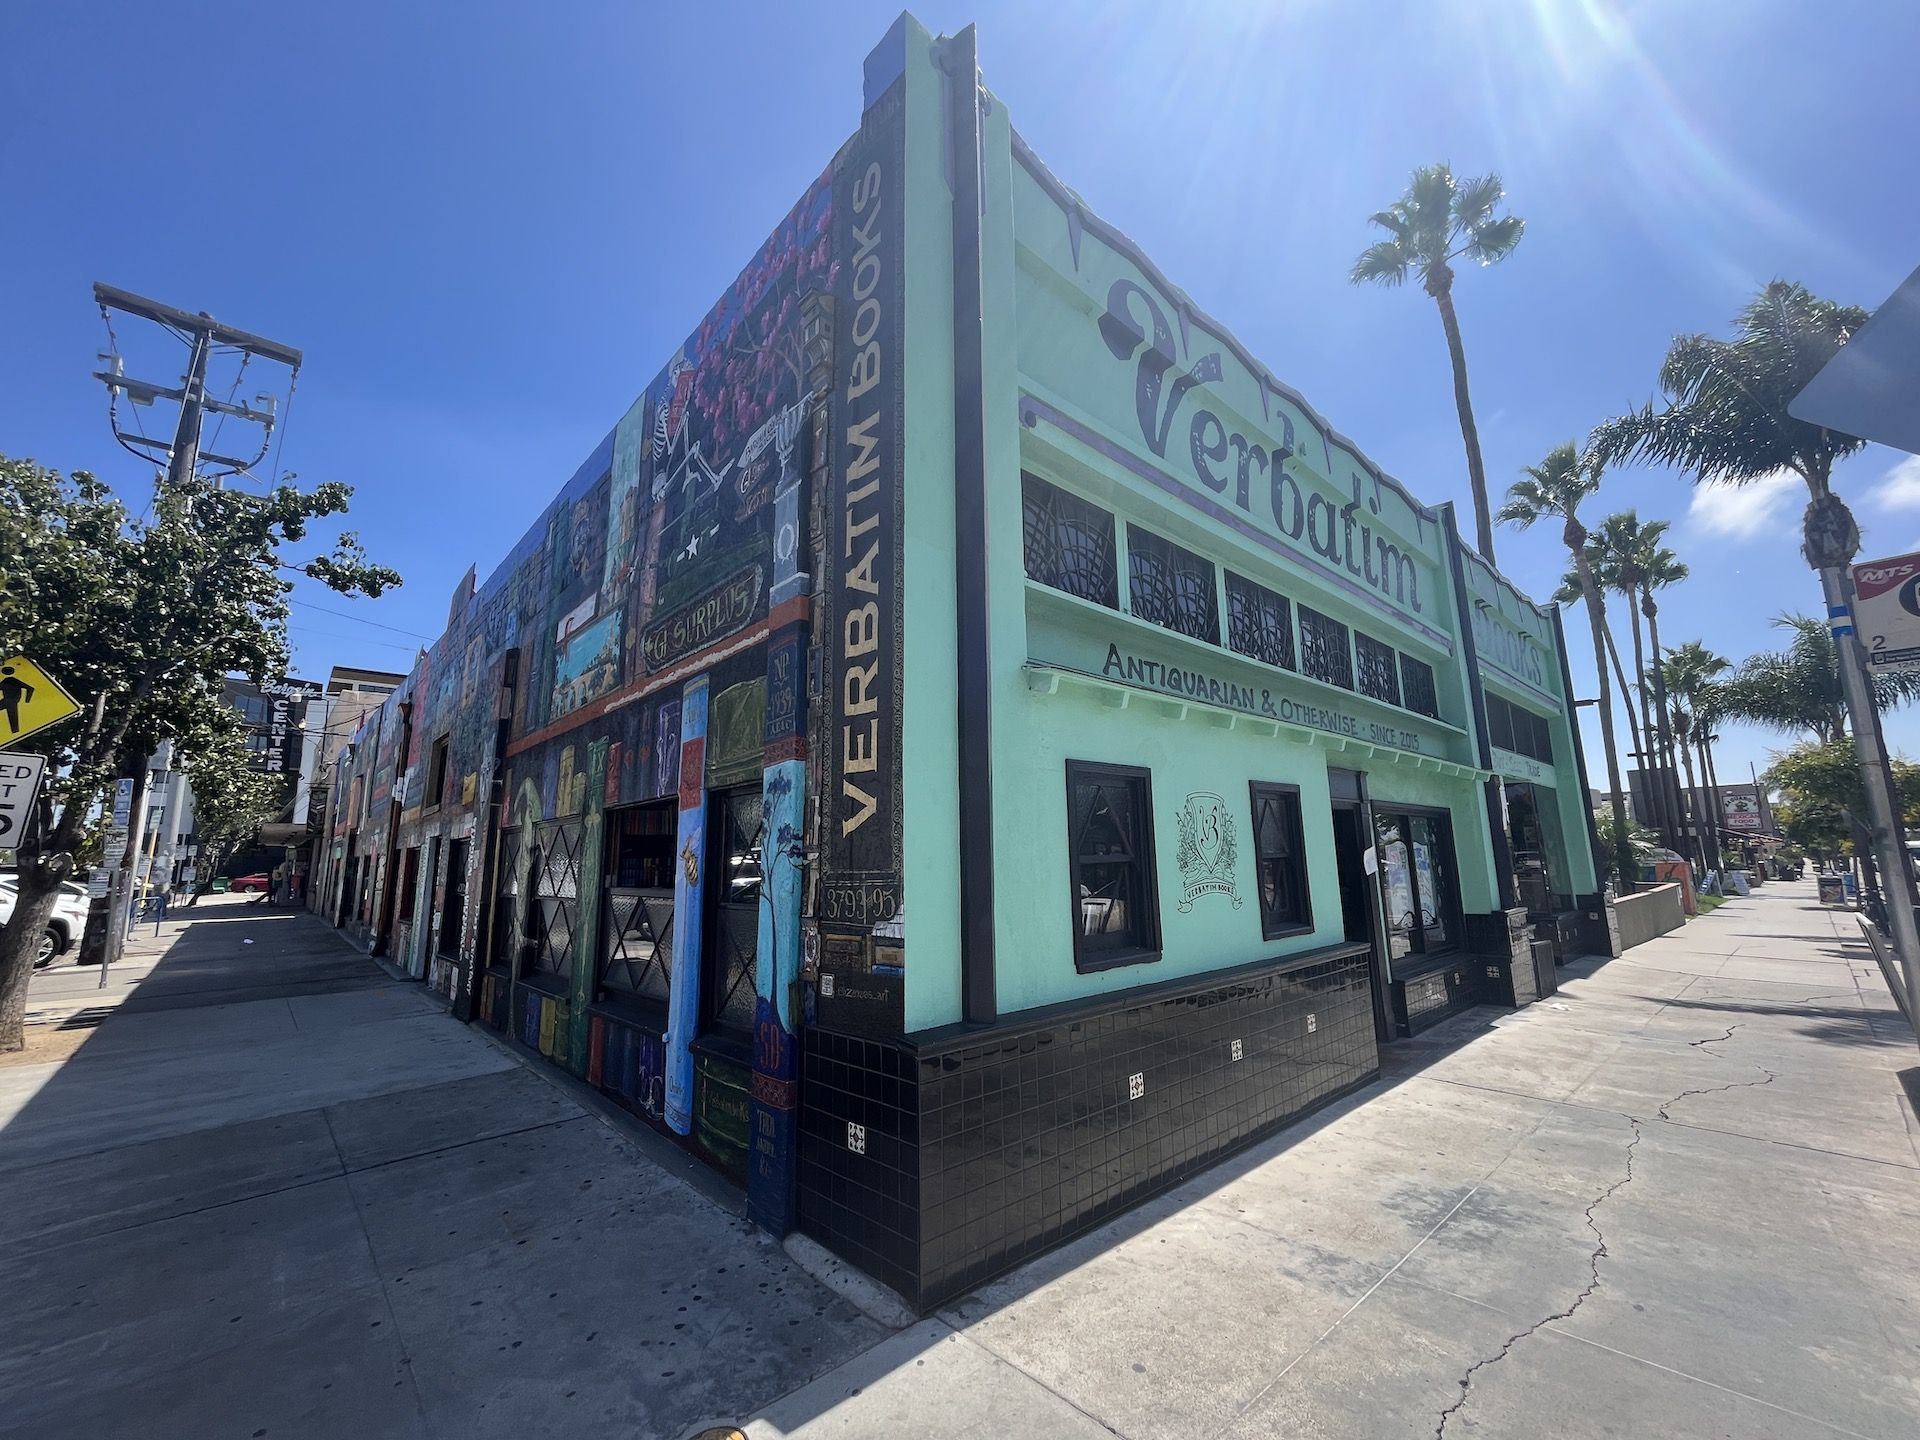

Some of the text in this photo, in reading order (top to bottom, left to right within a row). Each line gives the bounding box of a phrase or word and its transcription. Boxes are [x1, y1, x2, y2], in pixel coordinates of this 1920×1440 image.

[1097, 278, 1421, 613] Verbatim
[841, 161, 882, 838] VERBATIM BOOKS
[1860, 564, 1914, 582] MTS
[673, 584, 750, 648] SURPLUS
[1872, 635, 1886, 650] 2
[1102, 643, 1420, 750] ANTIQUARIAN & OTHERWISE SINCE 2015
[267, 700, 289, 771] CENTER
